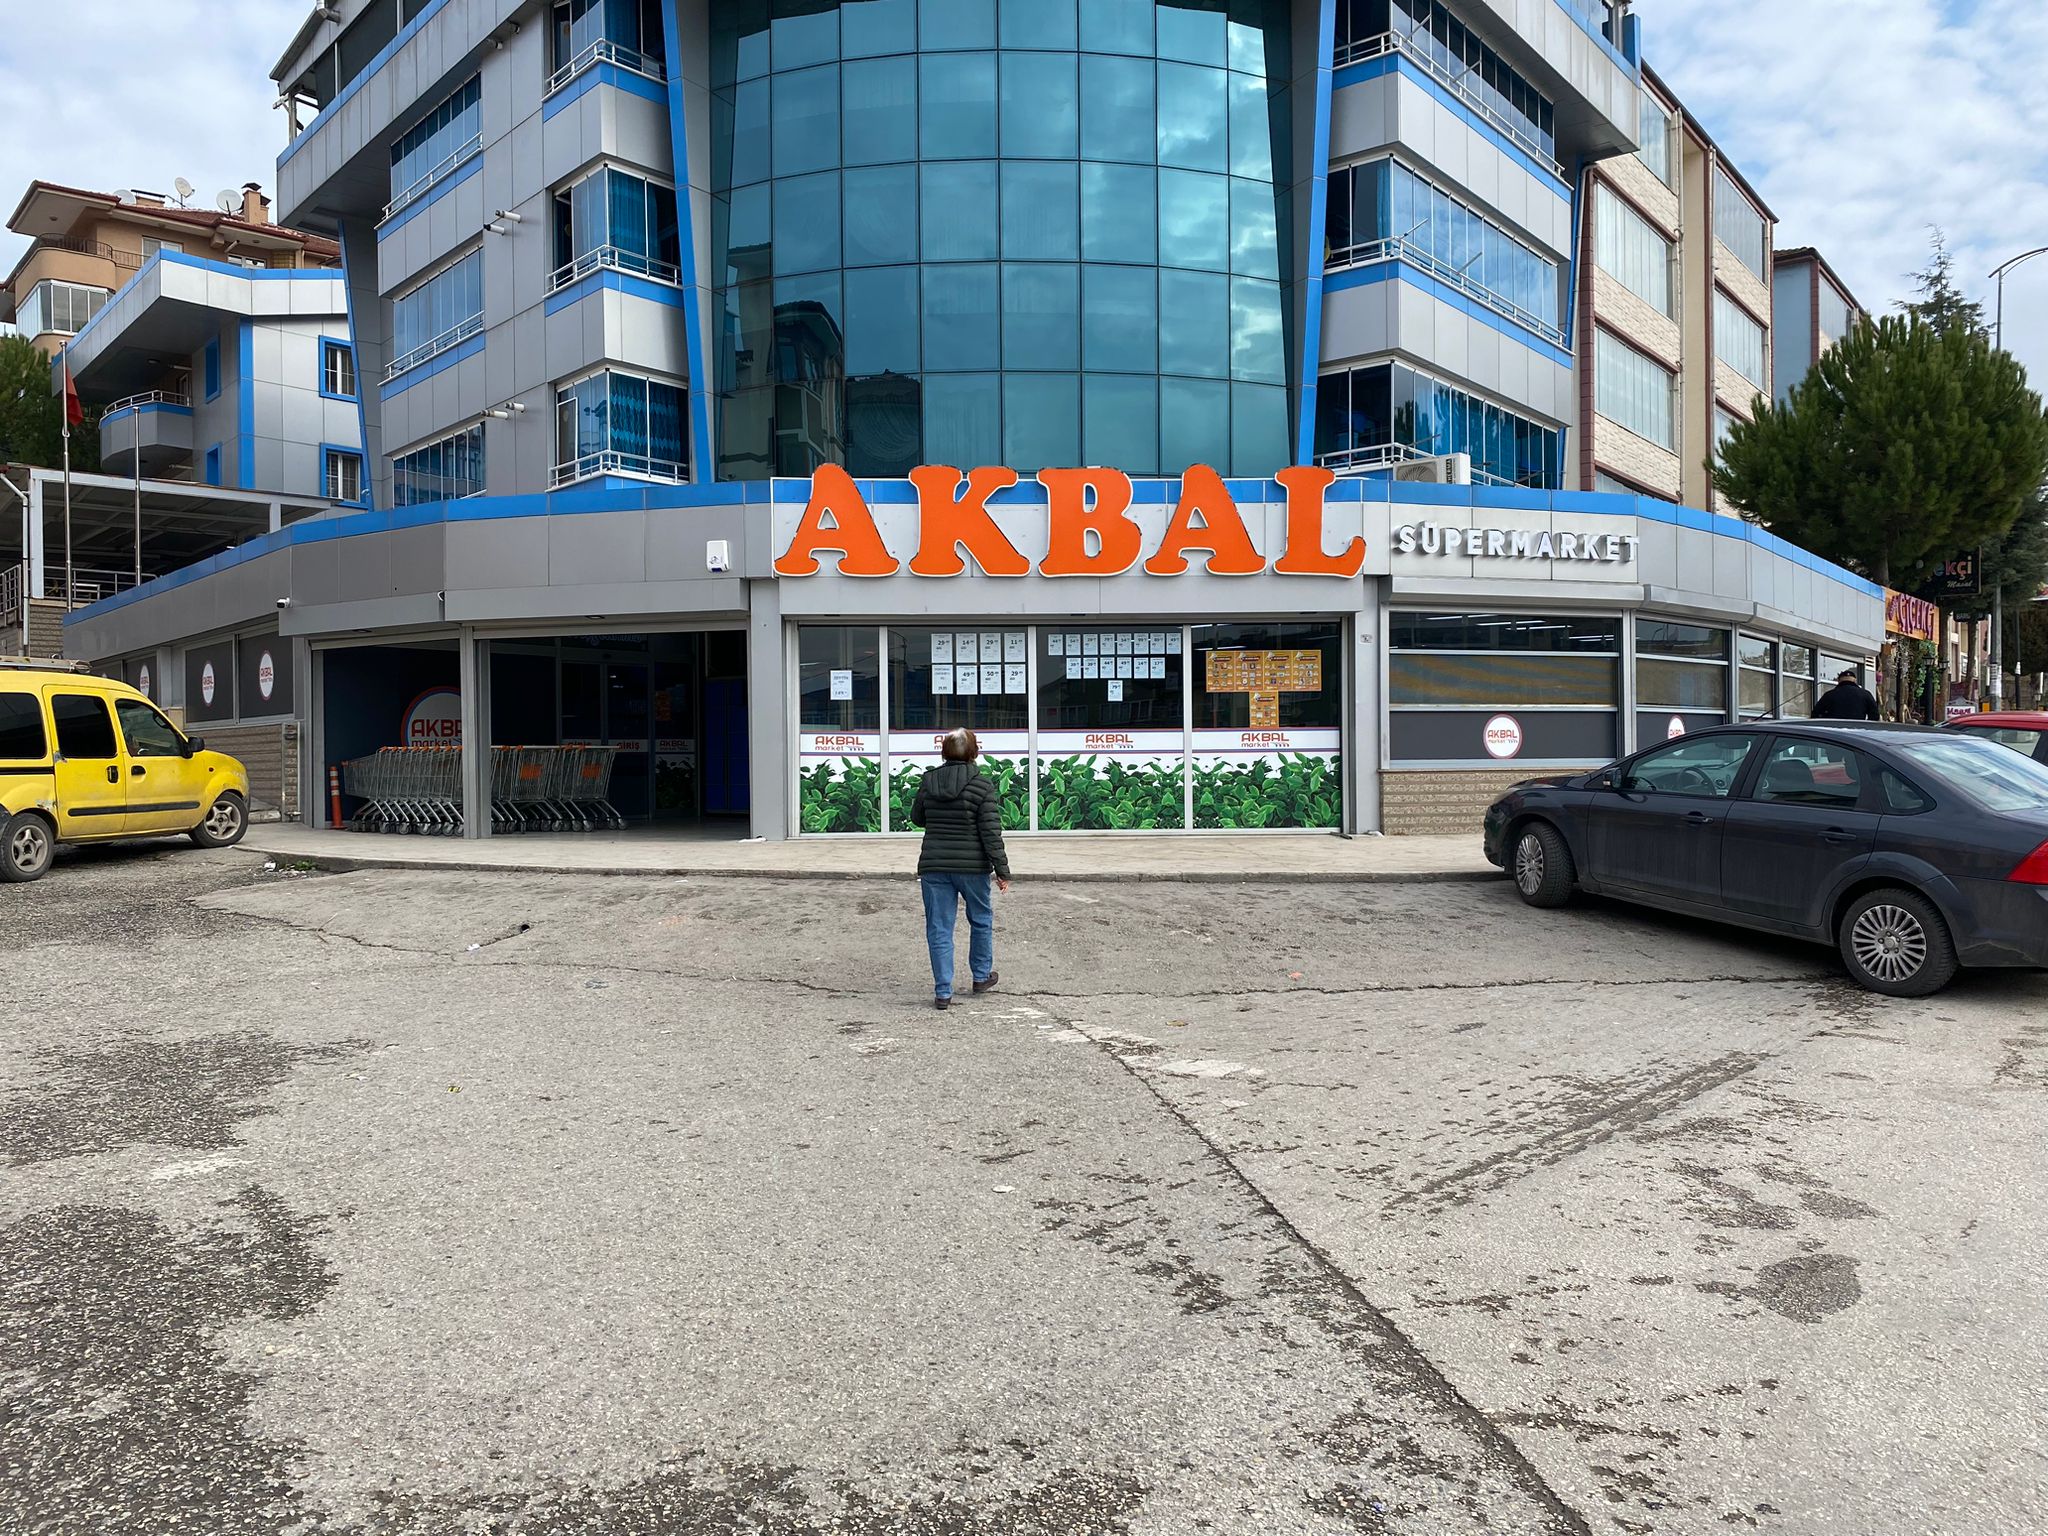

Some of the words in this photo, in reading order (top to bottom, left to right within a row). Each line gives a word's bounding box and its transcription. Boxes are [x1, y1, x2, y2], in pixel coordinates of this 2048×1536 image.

[773, 463, 1366, 578] AKBAL
[1393, 521, 1640, 562] SÜPERMARKET
[1241, 732, 1290, 742] AKBAL
[1487, 729, 1518, 738] AKBAL
[815, 736, 864, 745] AKBAL
[1085, 734, 1134, 743] AKBAL
